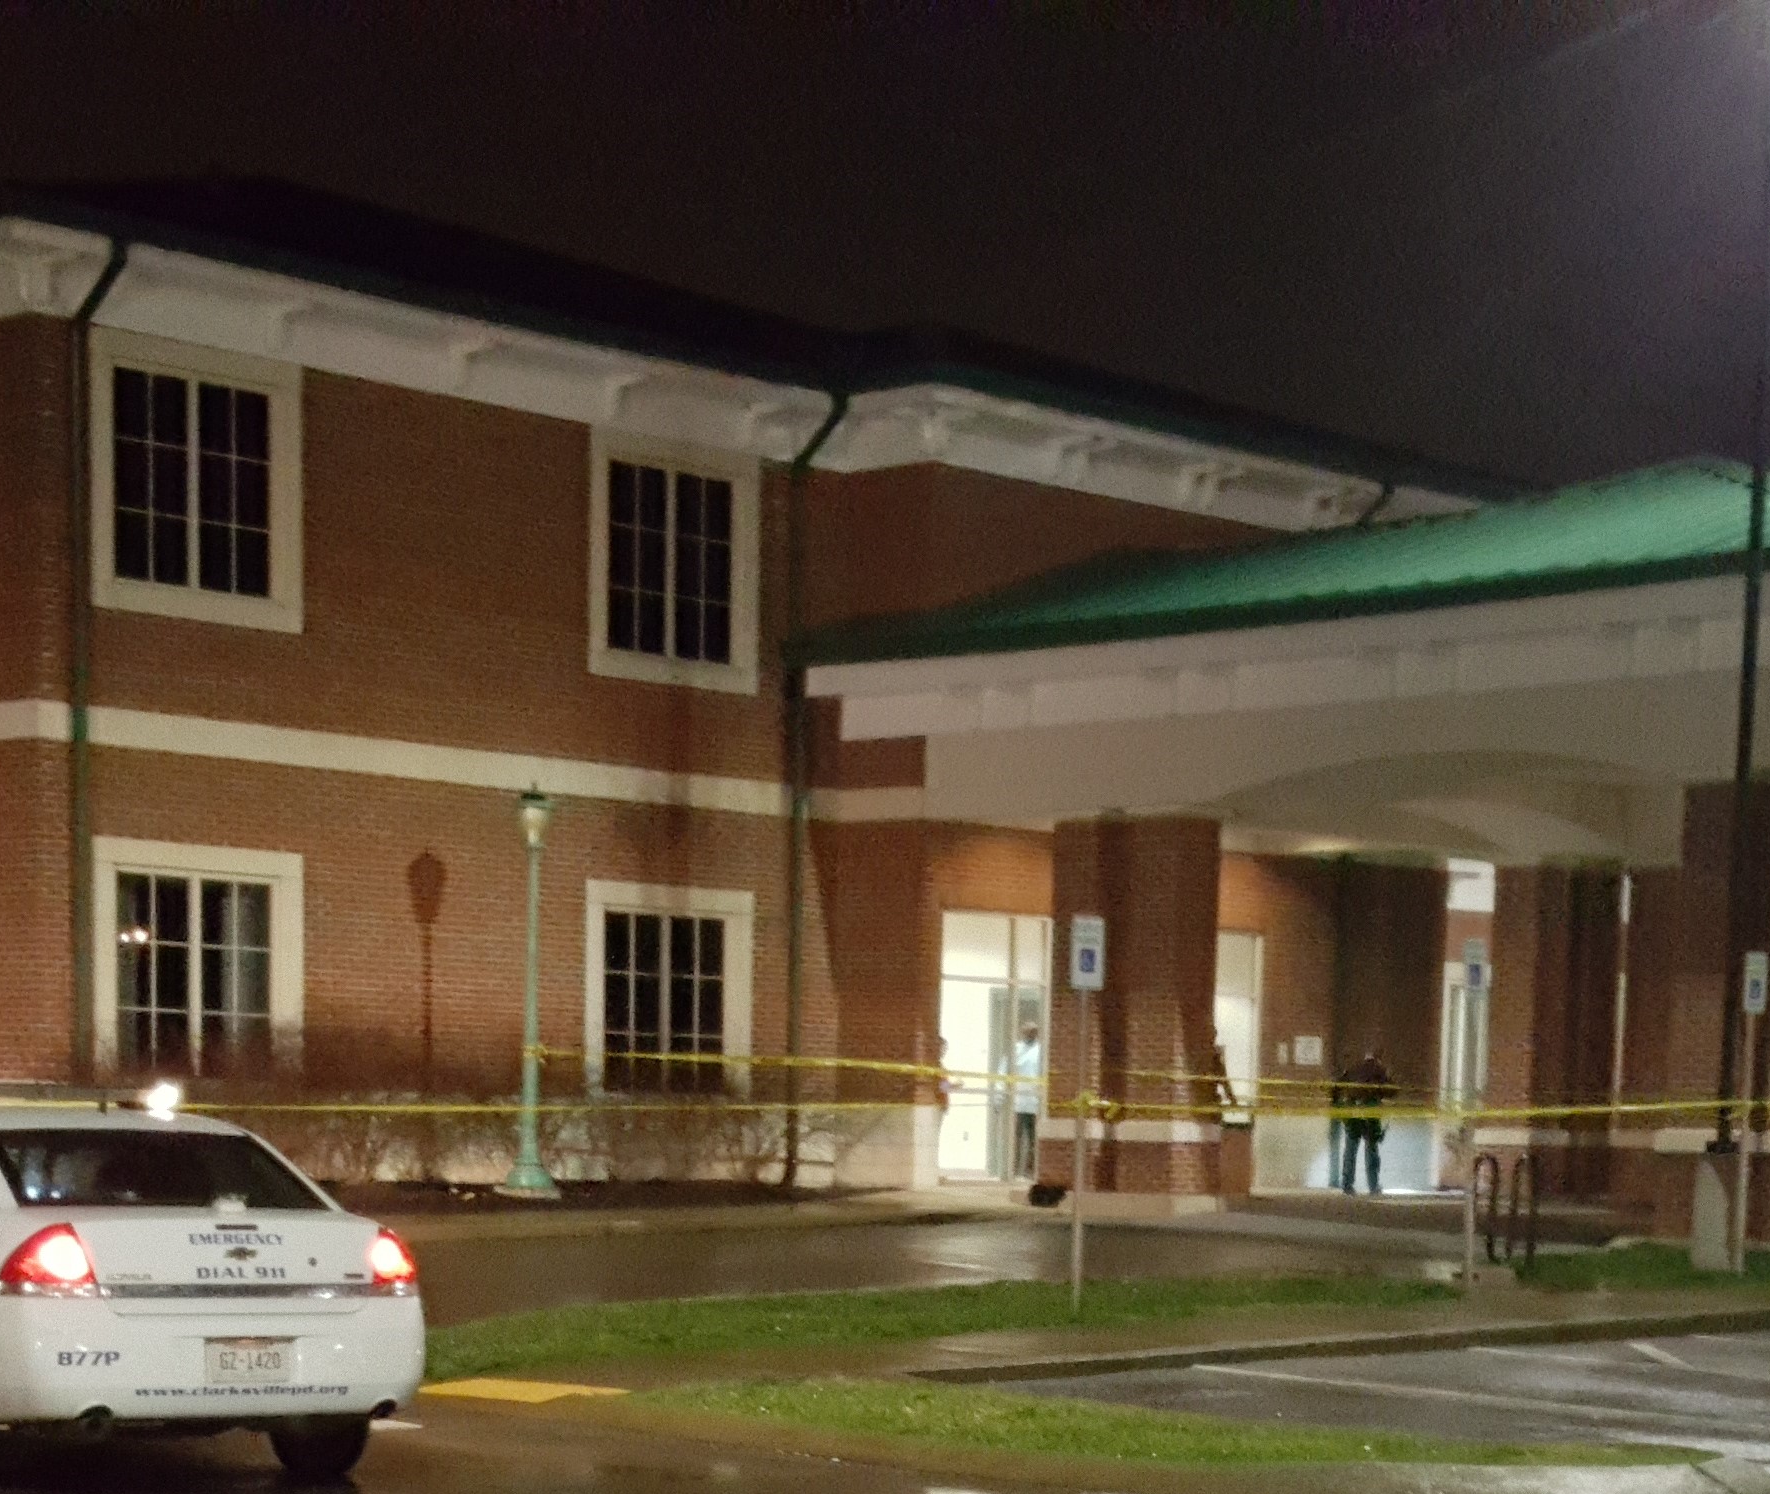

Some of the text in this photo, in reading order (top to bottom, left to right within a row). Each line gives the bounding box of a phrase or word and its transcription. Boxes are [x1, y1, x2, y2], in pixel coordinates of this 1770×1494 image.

[188, 1233, 283, 1246] EMERGENCY
[195, 1266, 286, 1280] DIAL 911
[134, 1385, 349, 1397] www.clarksvillepd.org
